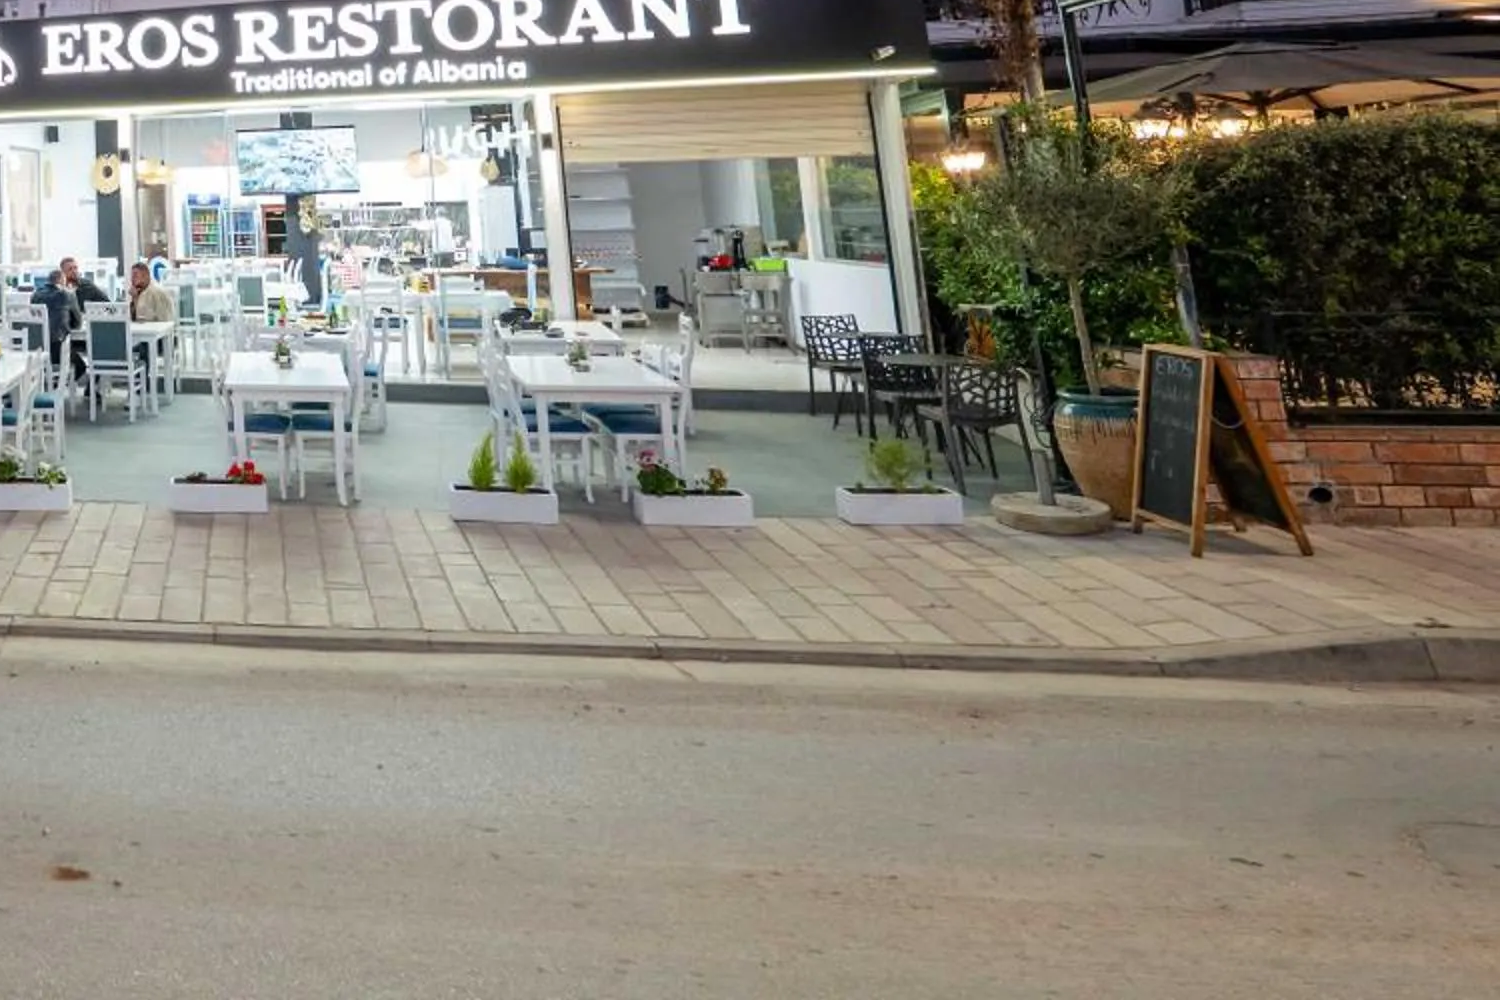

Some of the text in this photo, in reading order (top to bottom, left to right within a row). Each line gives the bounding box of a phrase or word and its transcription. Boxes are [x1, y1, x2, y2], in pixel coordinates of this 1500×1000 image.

[41, 13, 220, 76] EROS
[231, 54, 528, 94] Traditional of Albania
